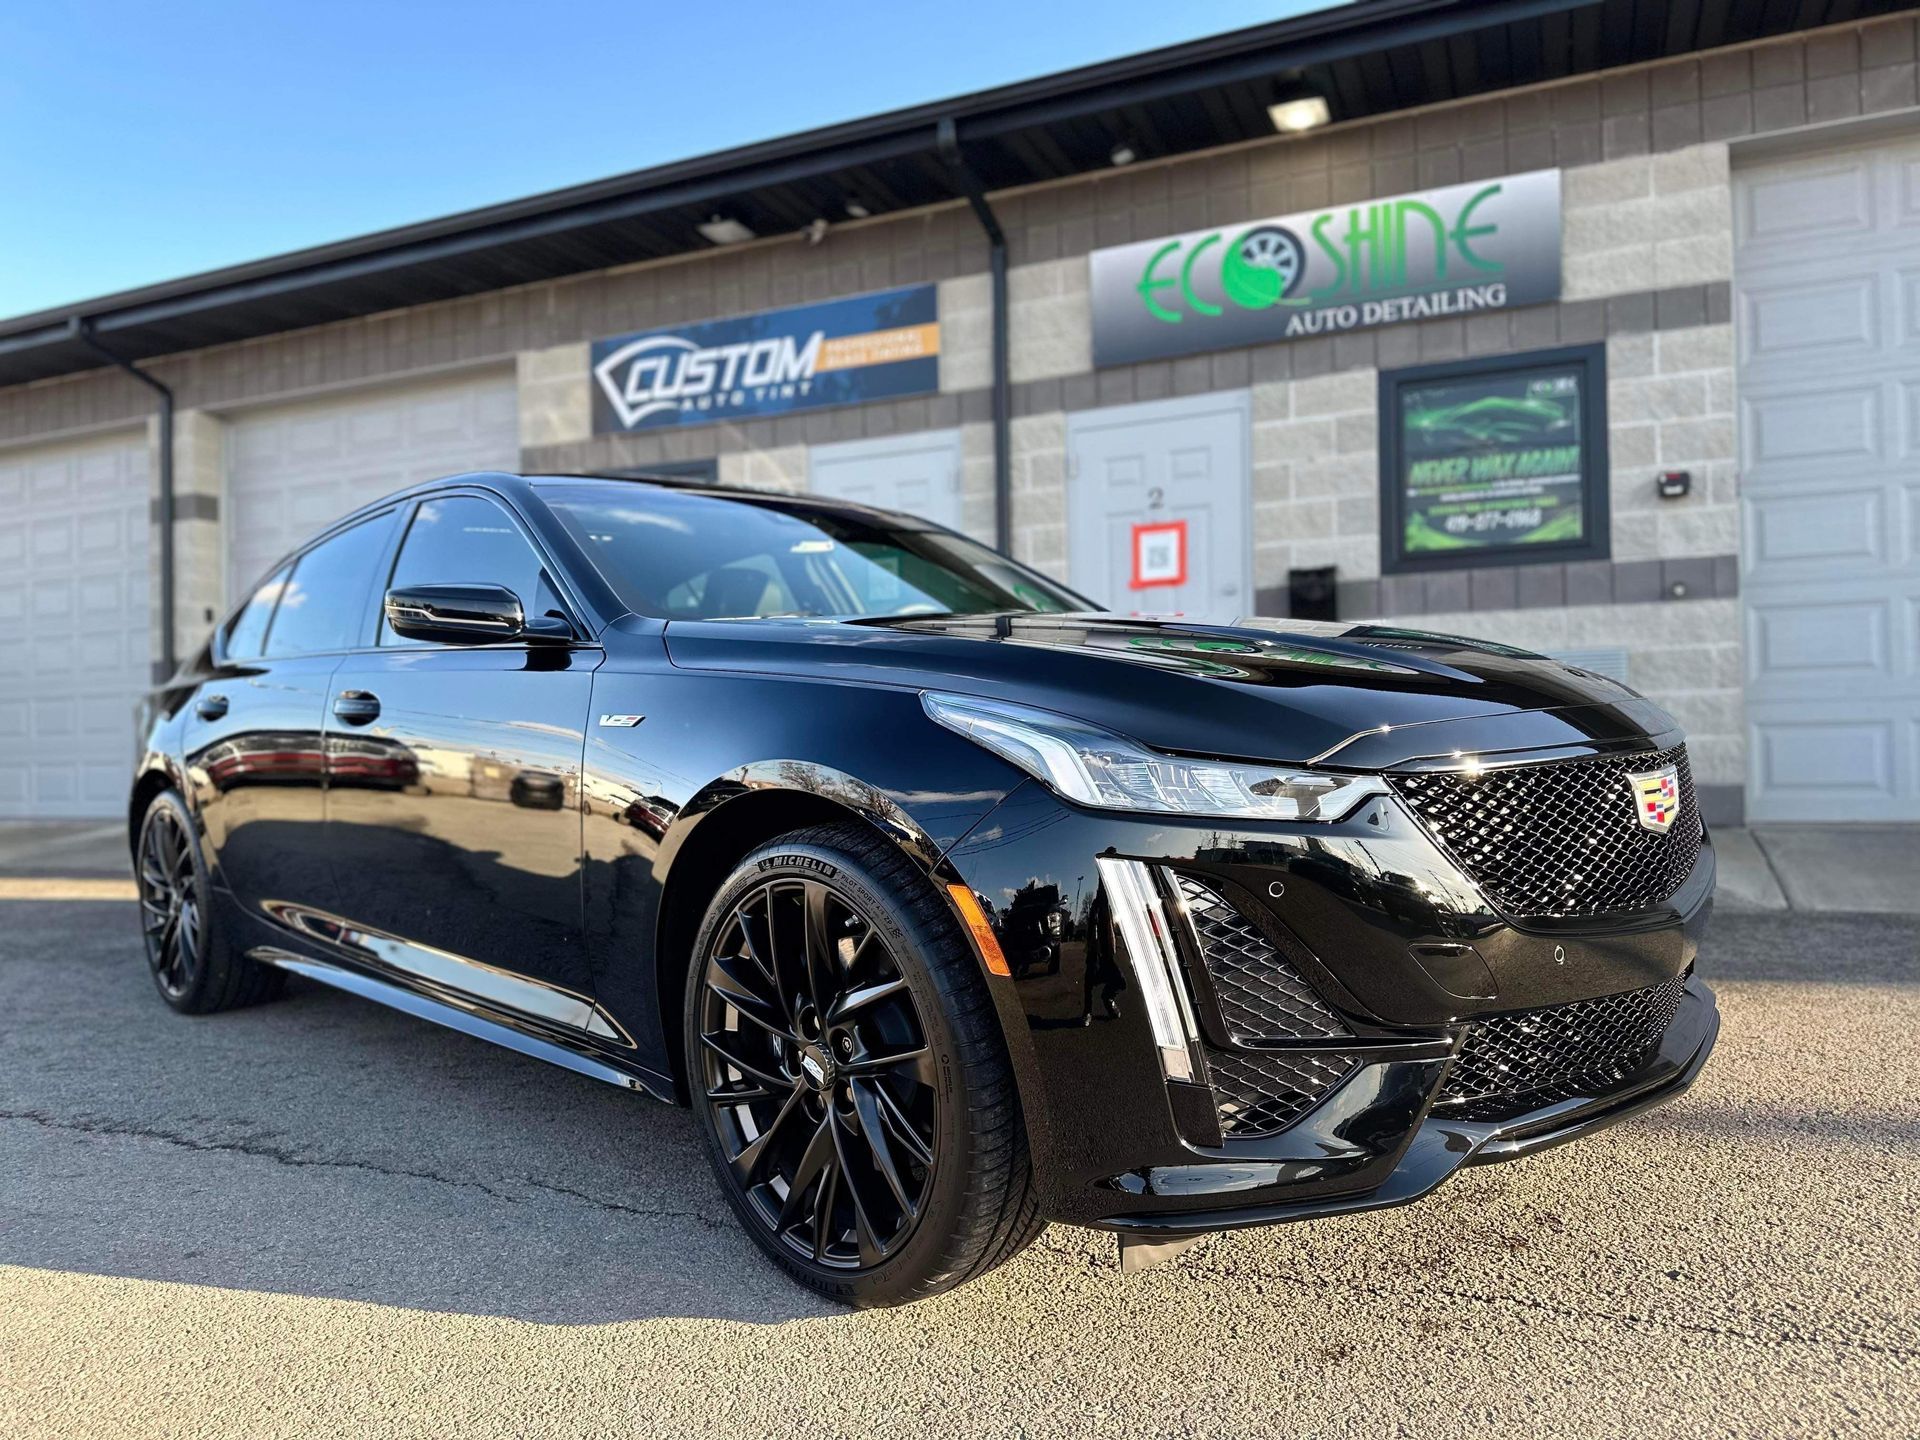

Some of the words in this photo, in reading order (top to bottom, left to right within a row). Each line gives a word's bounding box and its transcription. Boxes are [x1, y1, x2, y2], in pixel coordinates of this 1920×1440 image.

[1285, 305, 1357, 336] AUTO
[1362, 283, 1506, 325] DETAILING
[624, 331, 824, 404] CUSTOM
[681, 387, 745, 412] AUTO
[755, 381, 813, 401] TINT
[1408, 456, 1469, 486] NEVER
[1470, 452, 1518, 482] WAX
[1147, 486, 1164, 510] 2
[772, 855, 834, 876] MICHELIN
